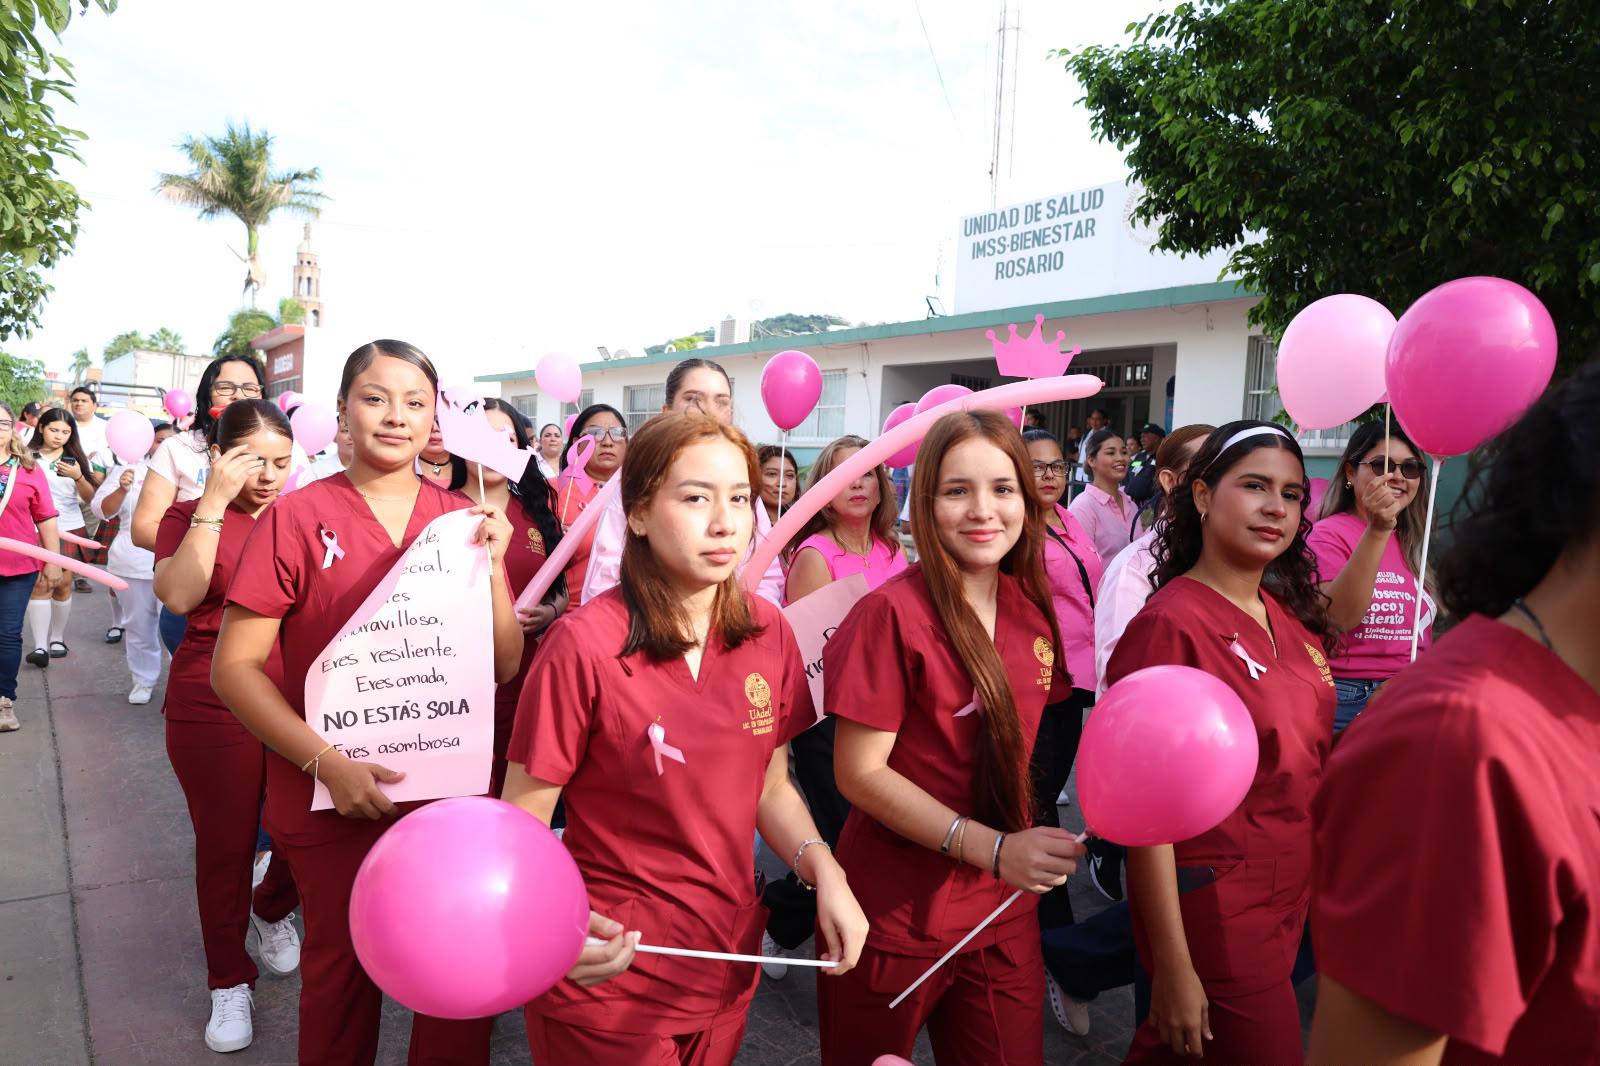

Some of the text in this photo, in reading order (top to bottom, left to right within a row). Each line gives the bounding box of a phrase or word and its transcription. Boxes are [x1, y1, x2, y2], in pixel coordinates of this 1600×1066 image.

[963, 207, 1019, 237] UNIDAD
[1024, 199, 1042, 226] DE
[1046, 188, 1104, 220] SALUD
[995, 251, 1064, 280] ROSARIO
[402, 549, 450, 575] ecial,
[1367, 602, 1397, 612] oco
[1372, 588, 1416, 603] bservo,
[339, 609, 443, 642] aravillosa,
[321, 636, 457, 674] Eres resiliente,
[323, 699, 470, 732] NO ESTÁS SOLA
[378, 733, 460, 755] asombrosa
